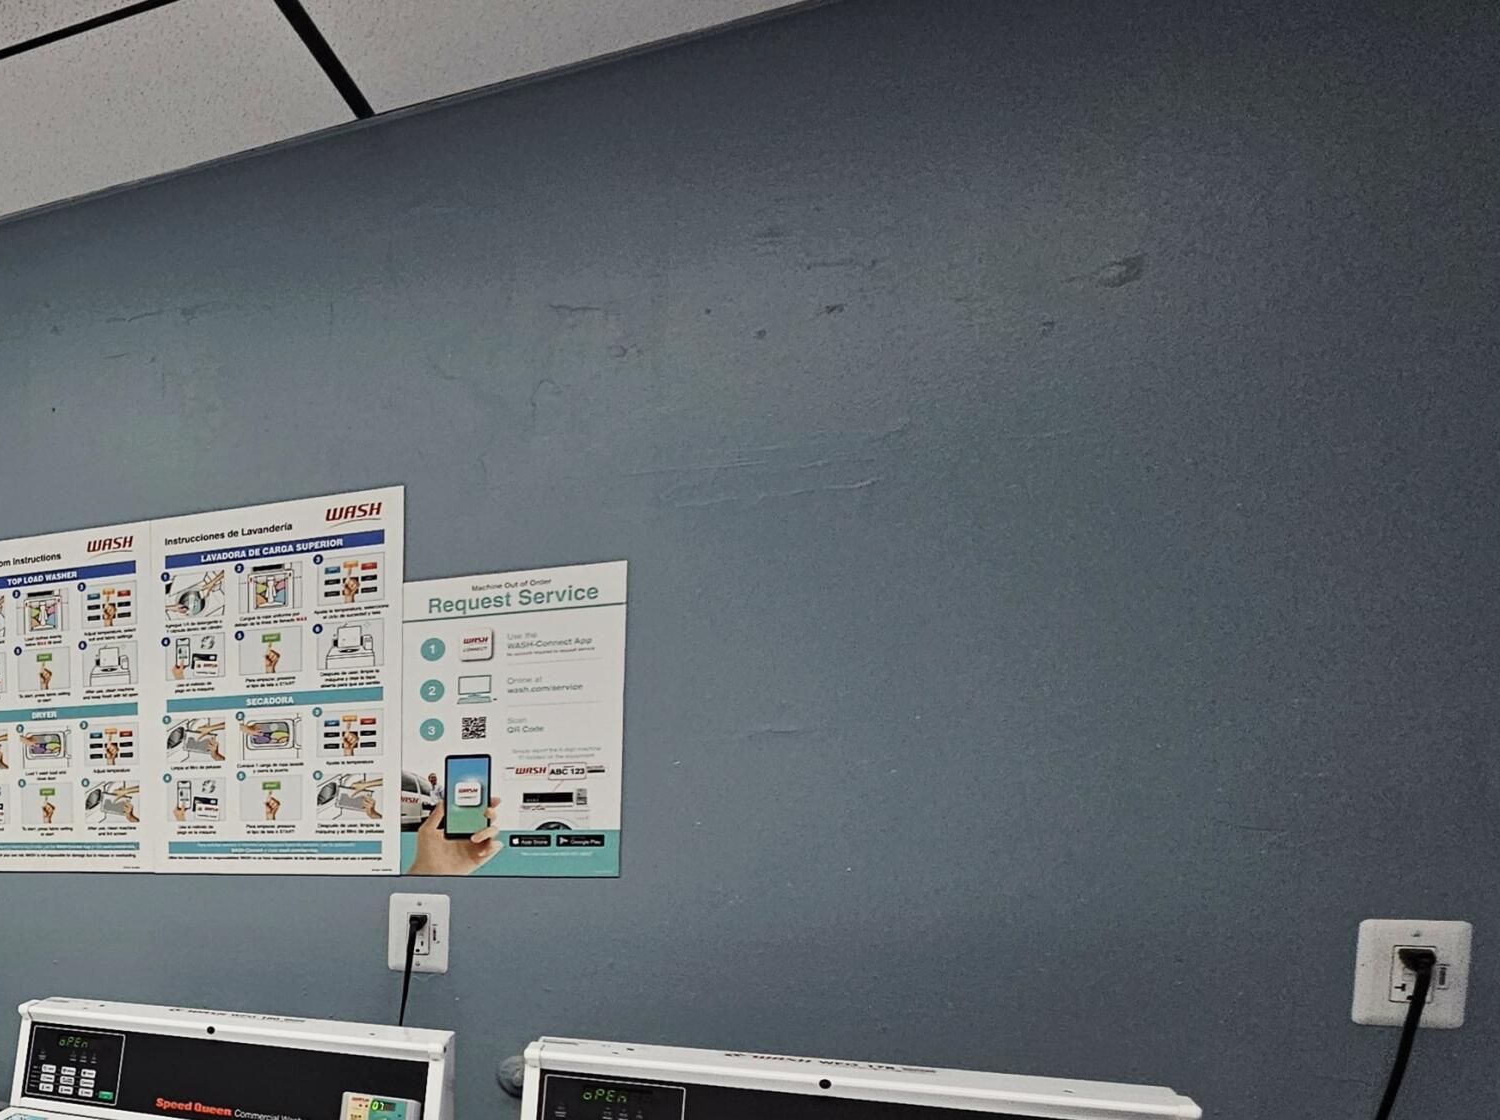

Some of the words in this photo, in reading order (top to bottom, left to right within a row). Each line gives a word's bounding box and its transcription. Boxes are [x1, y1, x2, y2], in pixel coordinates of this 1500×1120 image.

[325, 502, 382, 521] WASH
[165, 532, 225, 546] Instrucciones
[228, 529, 239, 538] de
[241, 522, 293, 536] Lavandería
[86, 536, 134, 552] WASH
[200, 551, 246, 563] LAVADORA
[248, 548, 261, 557] DE
[262, 543, 294, 556] CARGA
[295, 538, 343, 552] SUPERIOR
[12, 552, 61, 565] Instructions
[7, 577, 23, 586] TOP
[23, 574, 45, 585] LOAD
[45, 571, 78, 582] WASHER
[472, 583, 503, 593] Machine
[504, 582, 519, 590] Out
[529, 578, 552, 587] Order
[428, 590, 512, 616] Request
[517, 585, 599, 606] Service
[463, 636, 489, 645] WASH
[507, 638, 573, 650] WASH-Connect
[574, 637, 593, 646] App
[430, 644, 435, 654] 1
[428, 687, 436, 696] 2
[246, 696, 294, 706] SECADORA
[31, 711, 58, 720] DRYER
[428, 726, 436, 735] 3
[521, 725, 544, 734] Code
[515, 766, 547, 775] WASH
[549, 768, 568, 776] ABC
[570, 767, 585, 775] 123
[520, 838, 534, 846] App
[534, 838, 549, 846] Store
[156, 1097, 192, 1112] Speed
[194, 1102, 232, 1117] Queen
[371, 1100, 385, 1111] 07
